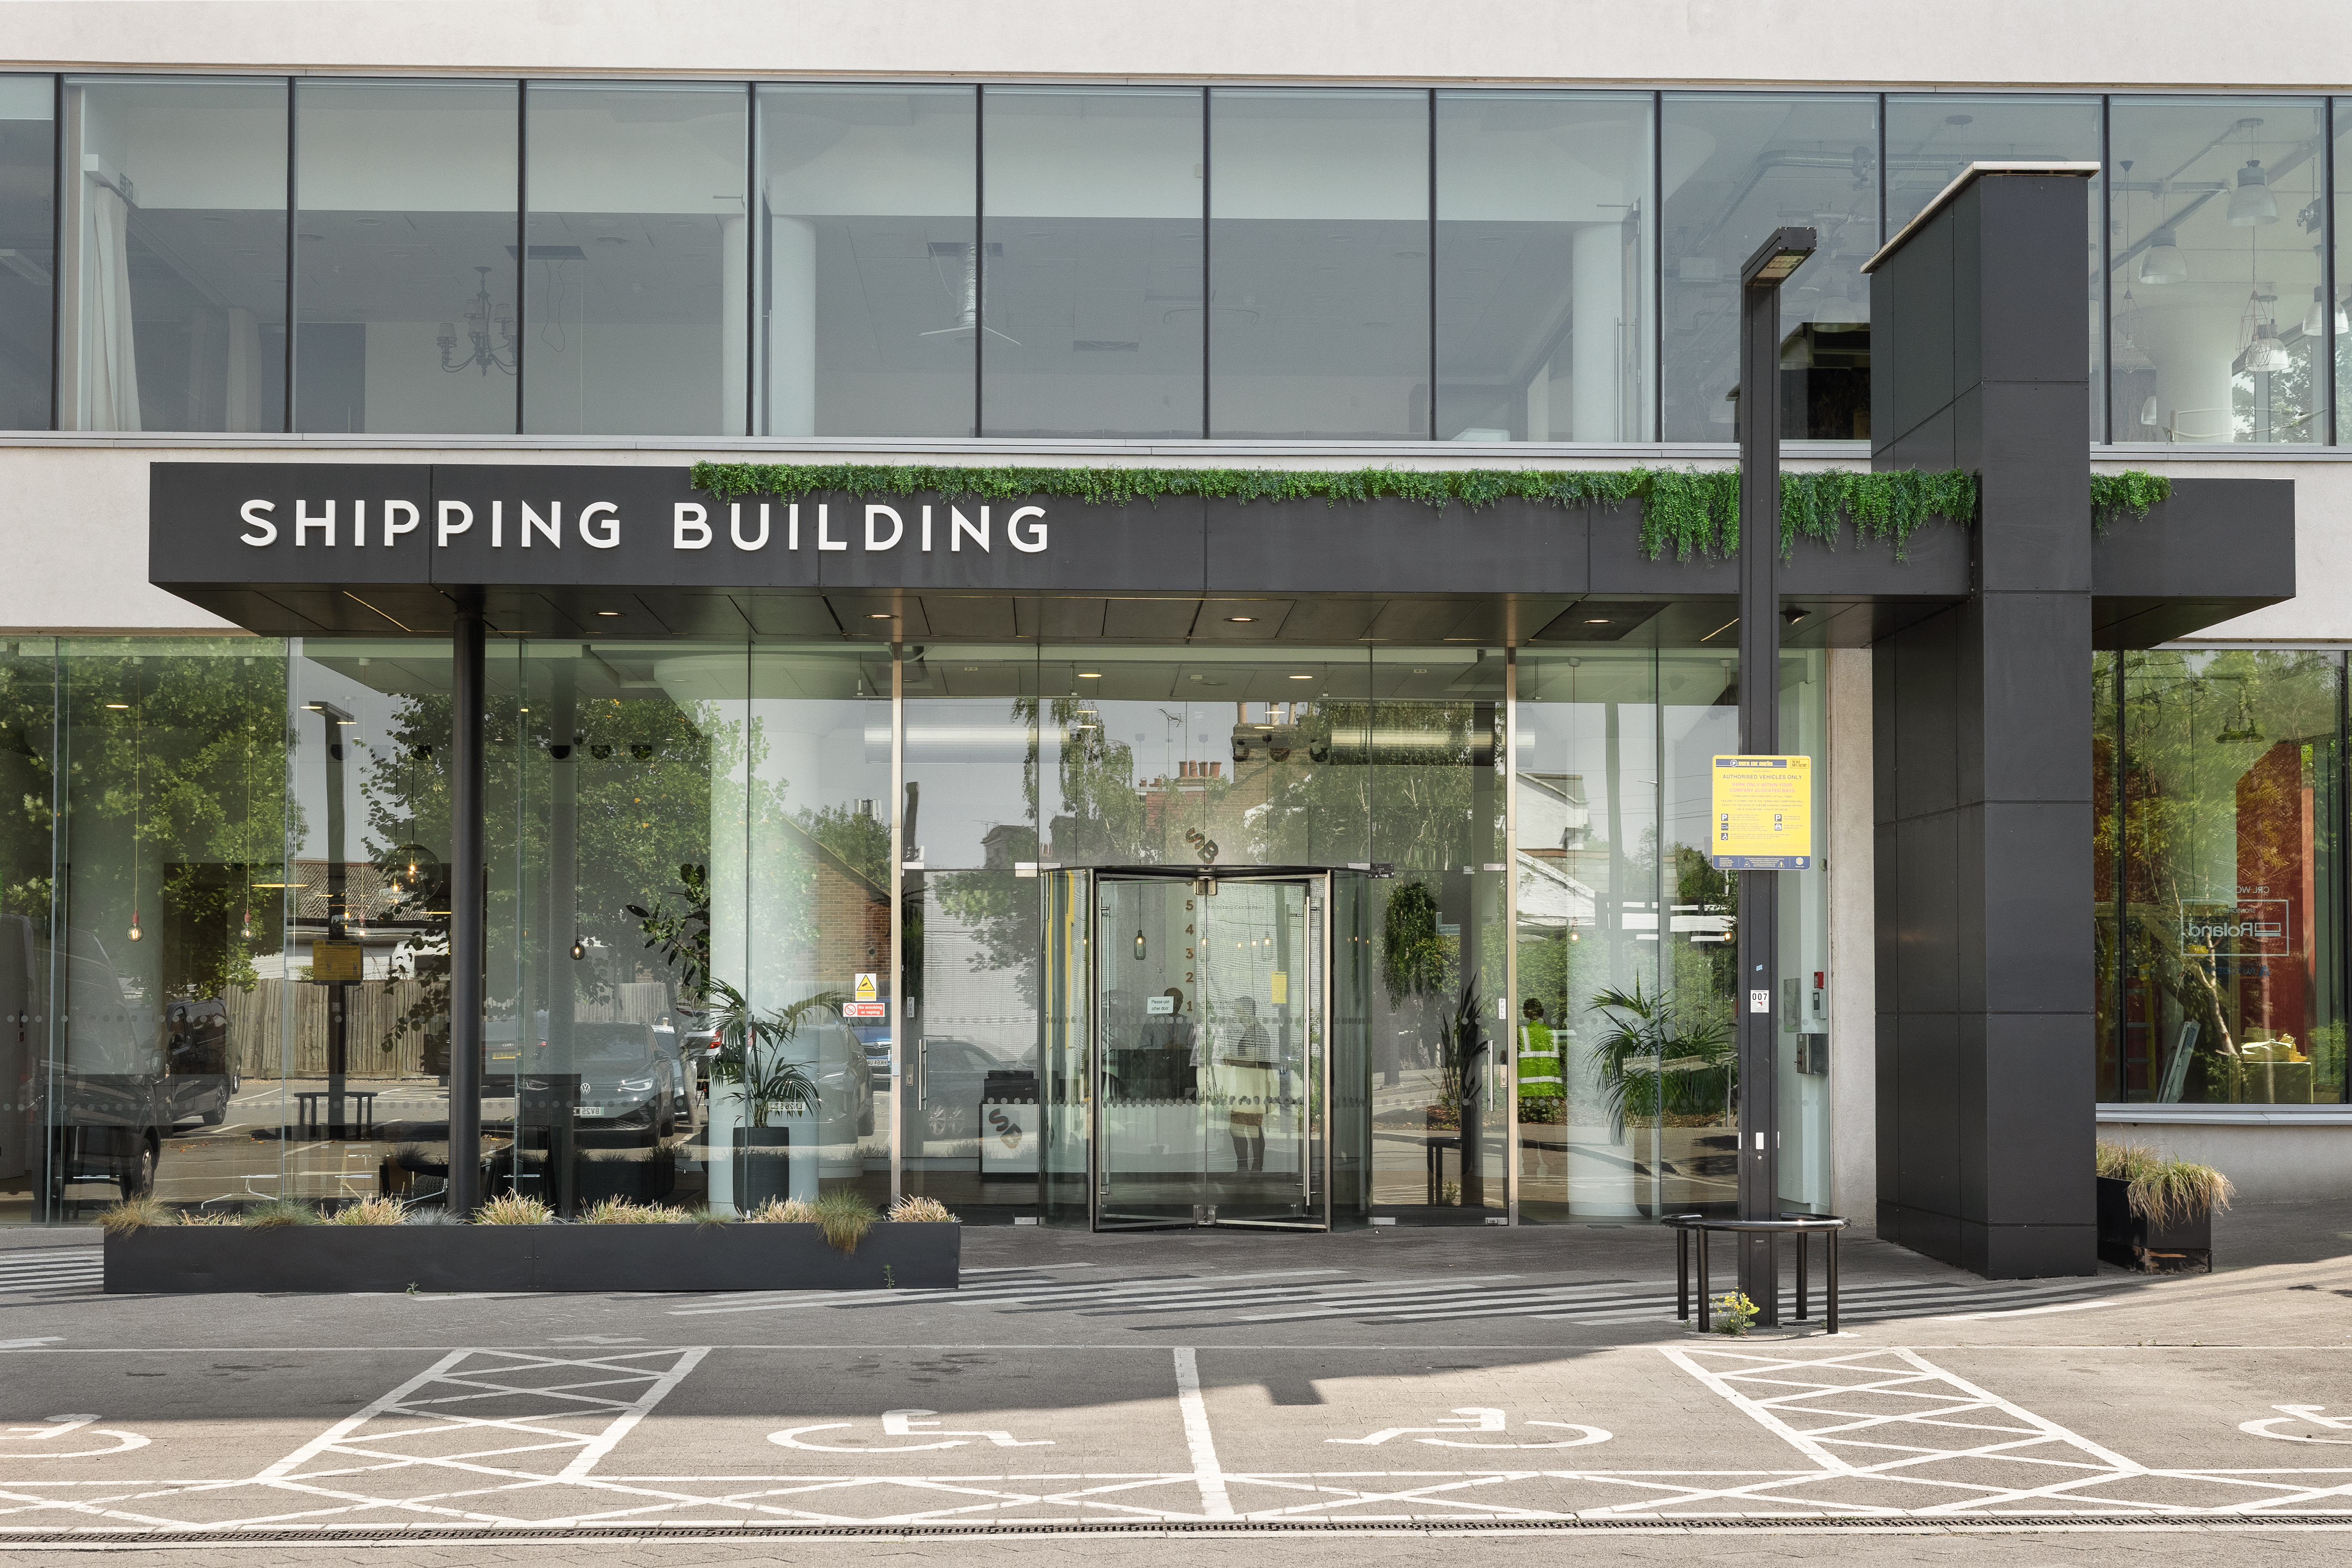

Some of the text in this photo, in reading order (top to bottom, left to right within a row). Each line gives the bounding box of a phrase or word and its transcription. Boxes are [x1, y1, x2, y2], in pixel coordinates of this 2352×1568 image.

[240, 499, 1047, 554] SHIPPING BUILDING
[1185, 827, 1219, 864] SB
[1185, 900, 1194, 910] 5
[1185, 924, 1194, 934] 4
[1185, 948, 1194, 959] 3
[1185, 972, 1194, 983] 2
[1187, 1001, 1192, 1011] 1
[989, 1108, 1023, 1148] SB
